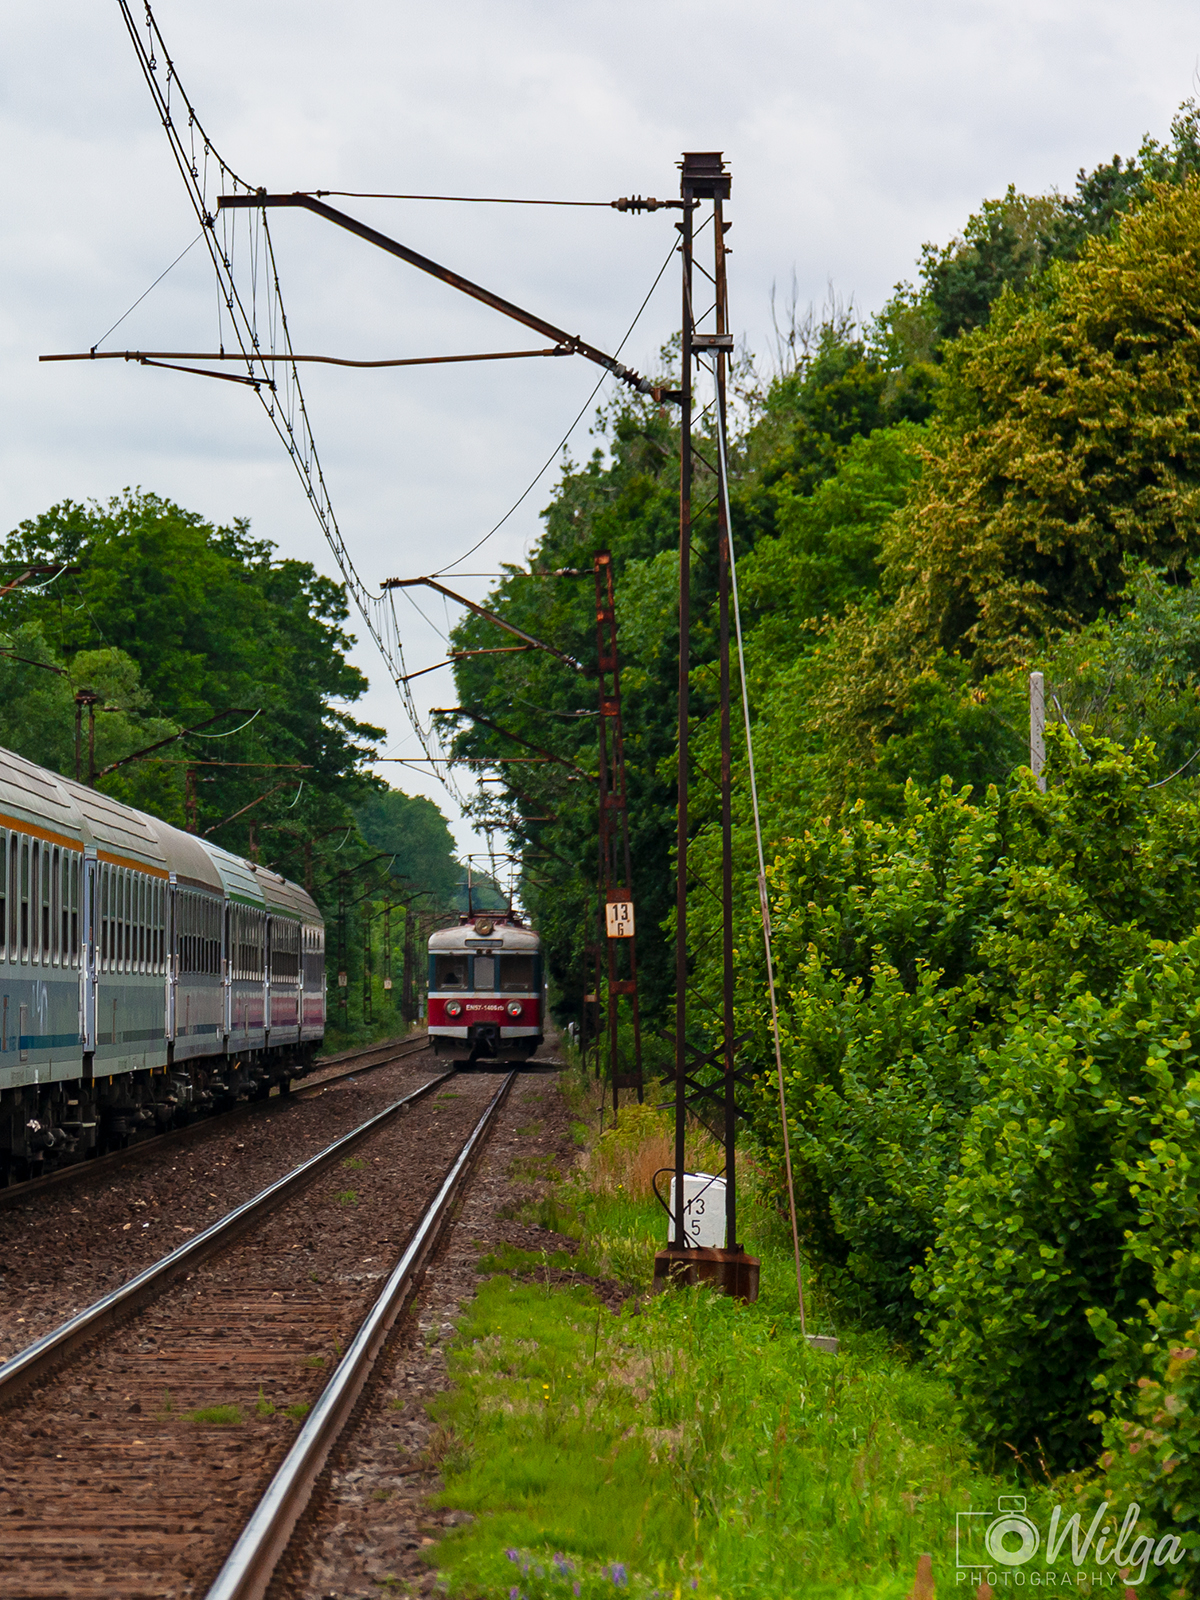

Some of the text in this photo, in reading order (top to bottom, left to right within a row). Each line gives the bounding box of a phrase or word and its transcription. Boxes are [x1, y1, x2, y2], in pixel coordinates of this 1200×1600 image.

[612, 904, 628, 921] 13
[617, 922, 624, 936] 6
[687, 1198, 705, 1215] 13
[691, 1219, 701, 1236] 5
